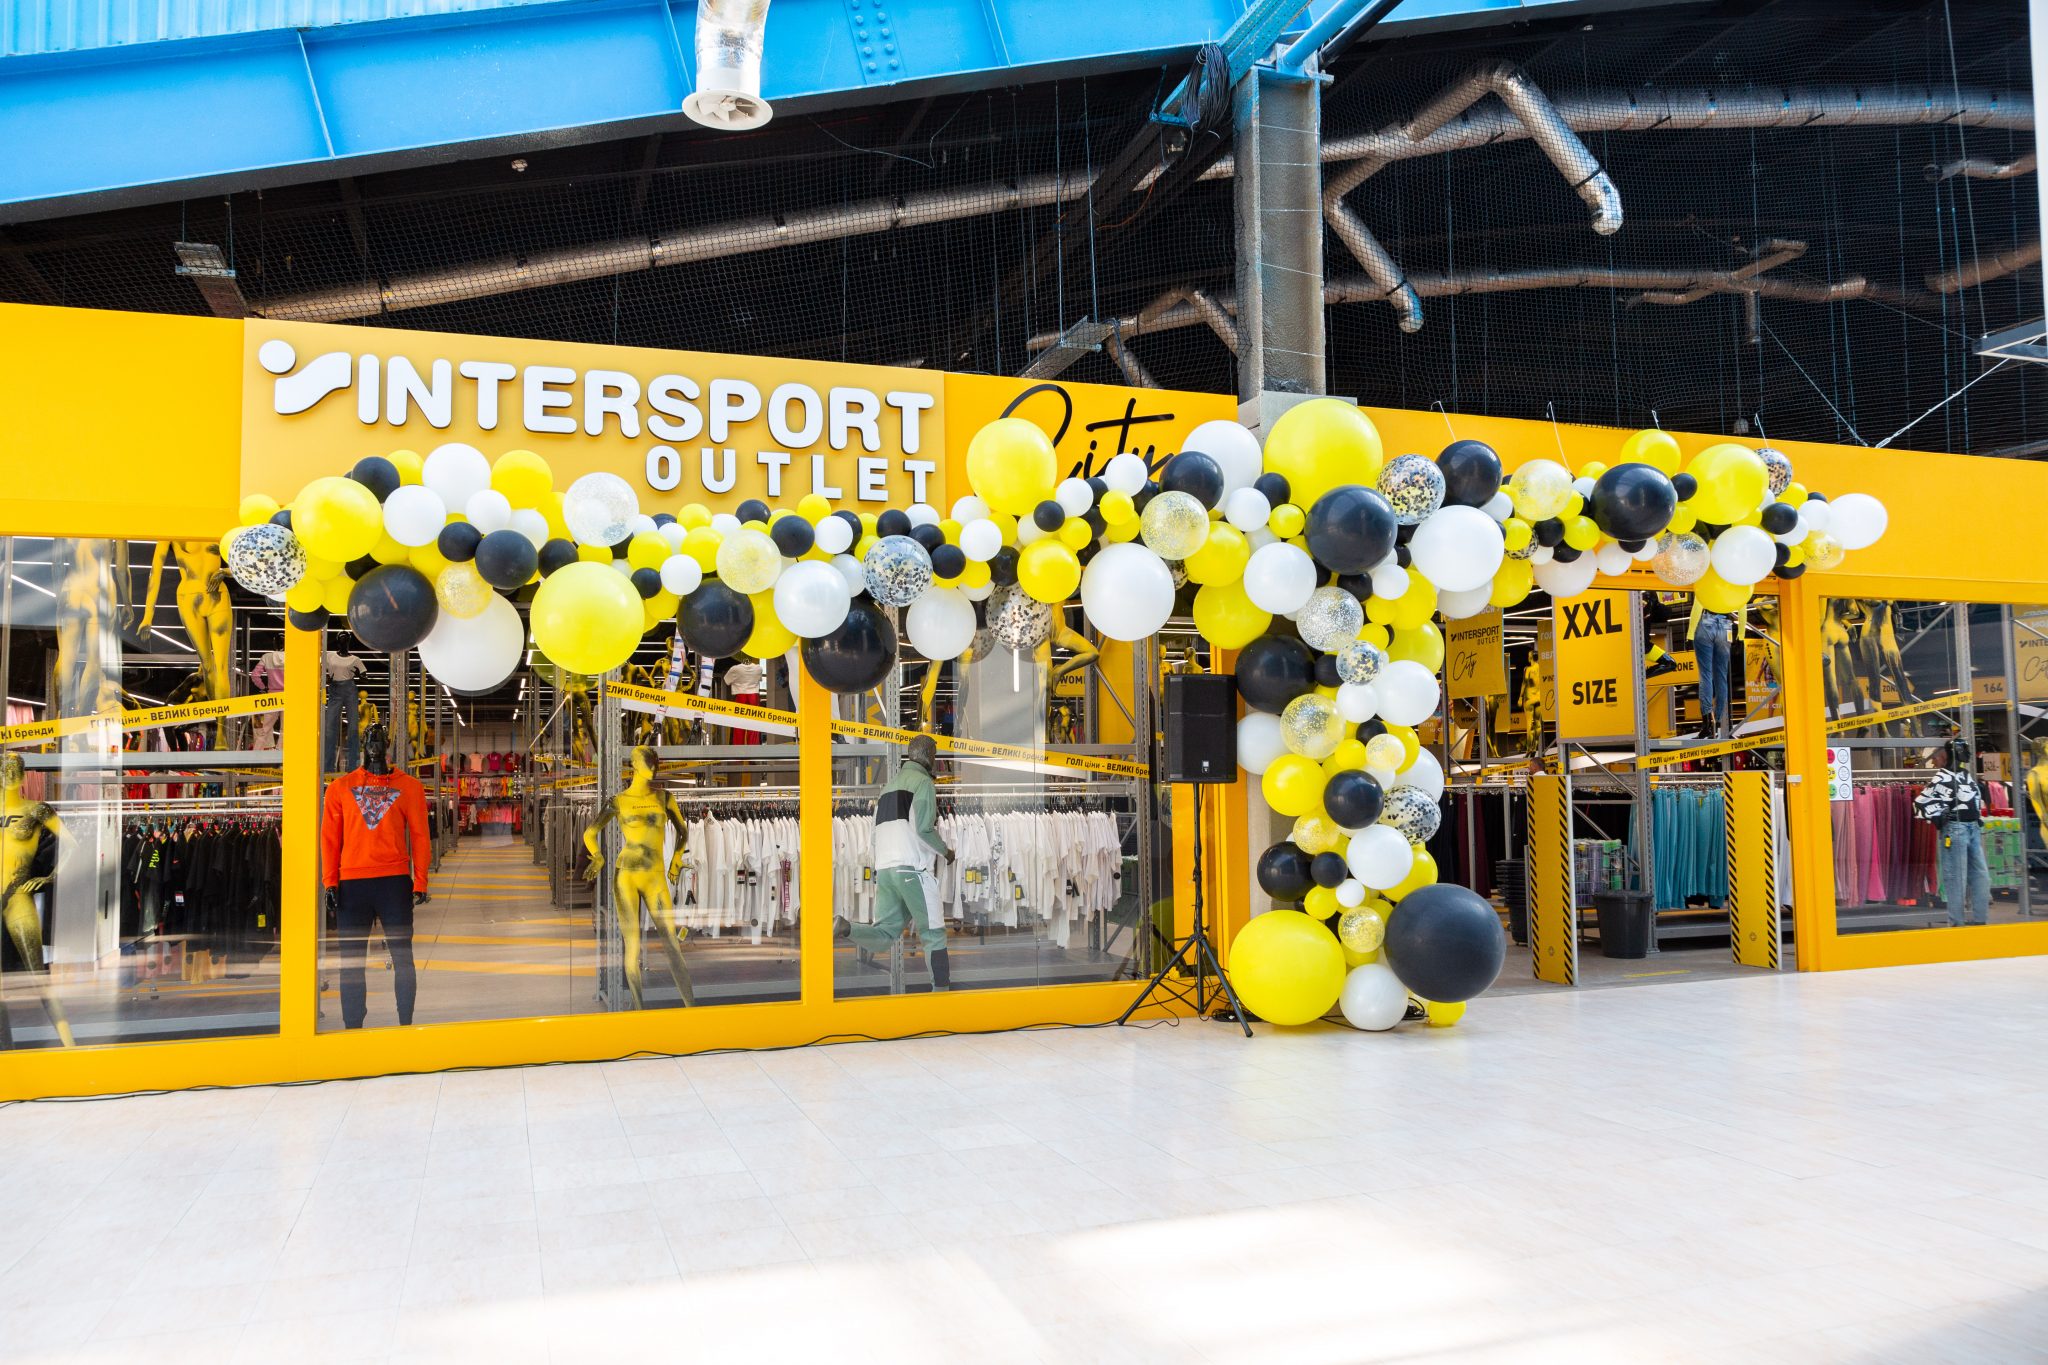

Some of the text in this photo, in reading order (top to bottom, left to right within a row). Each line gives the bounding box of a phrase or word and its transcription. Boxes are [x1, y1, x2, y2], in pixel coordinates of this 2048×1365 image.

[358, 353, 935, 454] INTERSPORT
[645, 445, 936, 503] OUTLET
[1562, 598, 1623, 640] XXL
[1457, 625, 1500, 641] INTERSPORT
[1452, 651, 1478, 681] City
[606, 685, 666, 702] ЕЛИКІ бренди
[1572, 678, 1618, 705] SIZE
[1983, 683, 2003, 693] 164
[255, 697, 278, 708] ГОЛІ
[686, 698, 706, 709] ГОЛІ
[708, 703, 726, 712] ціни
[734, 706, 766, 719] ВЕЛИКІ
[767, 713, 797, 724] бренди
[150, 708, 190, 721] ВЕЛИКІ
[193, 705, 230, 717] бренди
[15, 726, 54, 740] бренди
[863, 727, 893, 740] ВЕЛИКІ
[895, 733, 915, 742] брен
[949, 740, 967, 750] ГОЛІ
[968, 744, 985, 753] ціни
[991, 746, 1021, 758] ВЕЛИКІ
[1066, 757, 1083, 767] ГОЛІ
[1085, 759, 1100, 769] ціни
[1107, 763, 1134, 774] ВЕЛИКІ
[1650, 757, 1663, 765] ГОЛІ
[1680, 751, 1700, 760] ВЕЛИКІ
